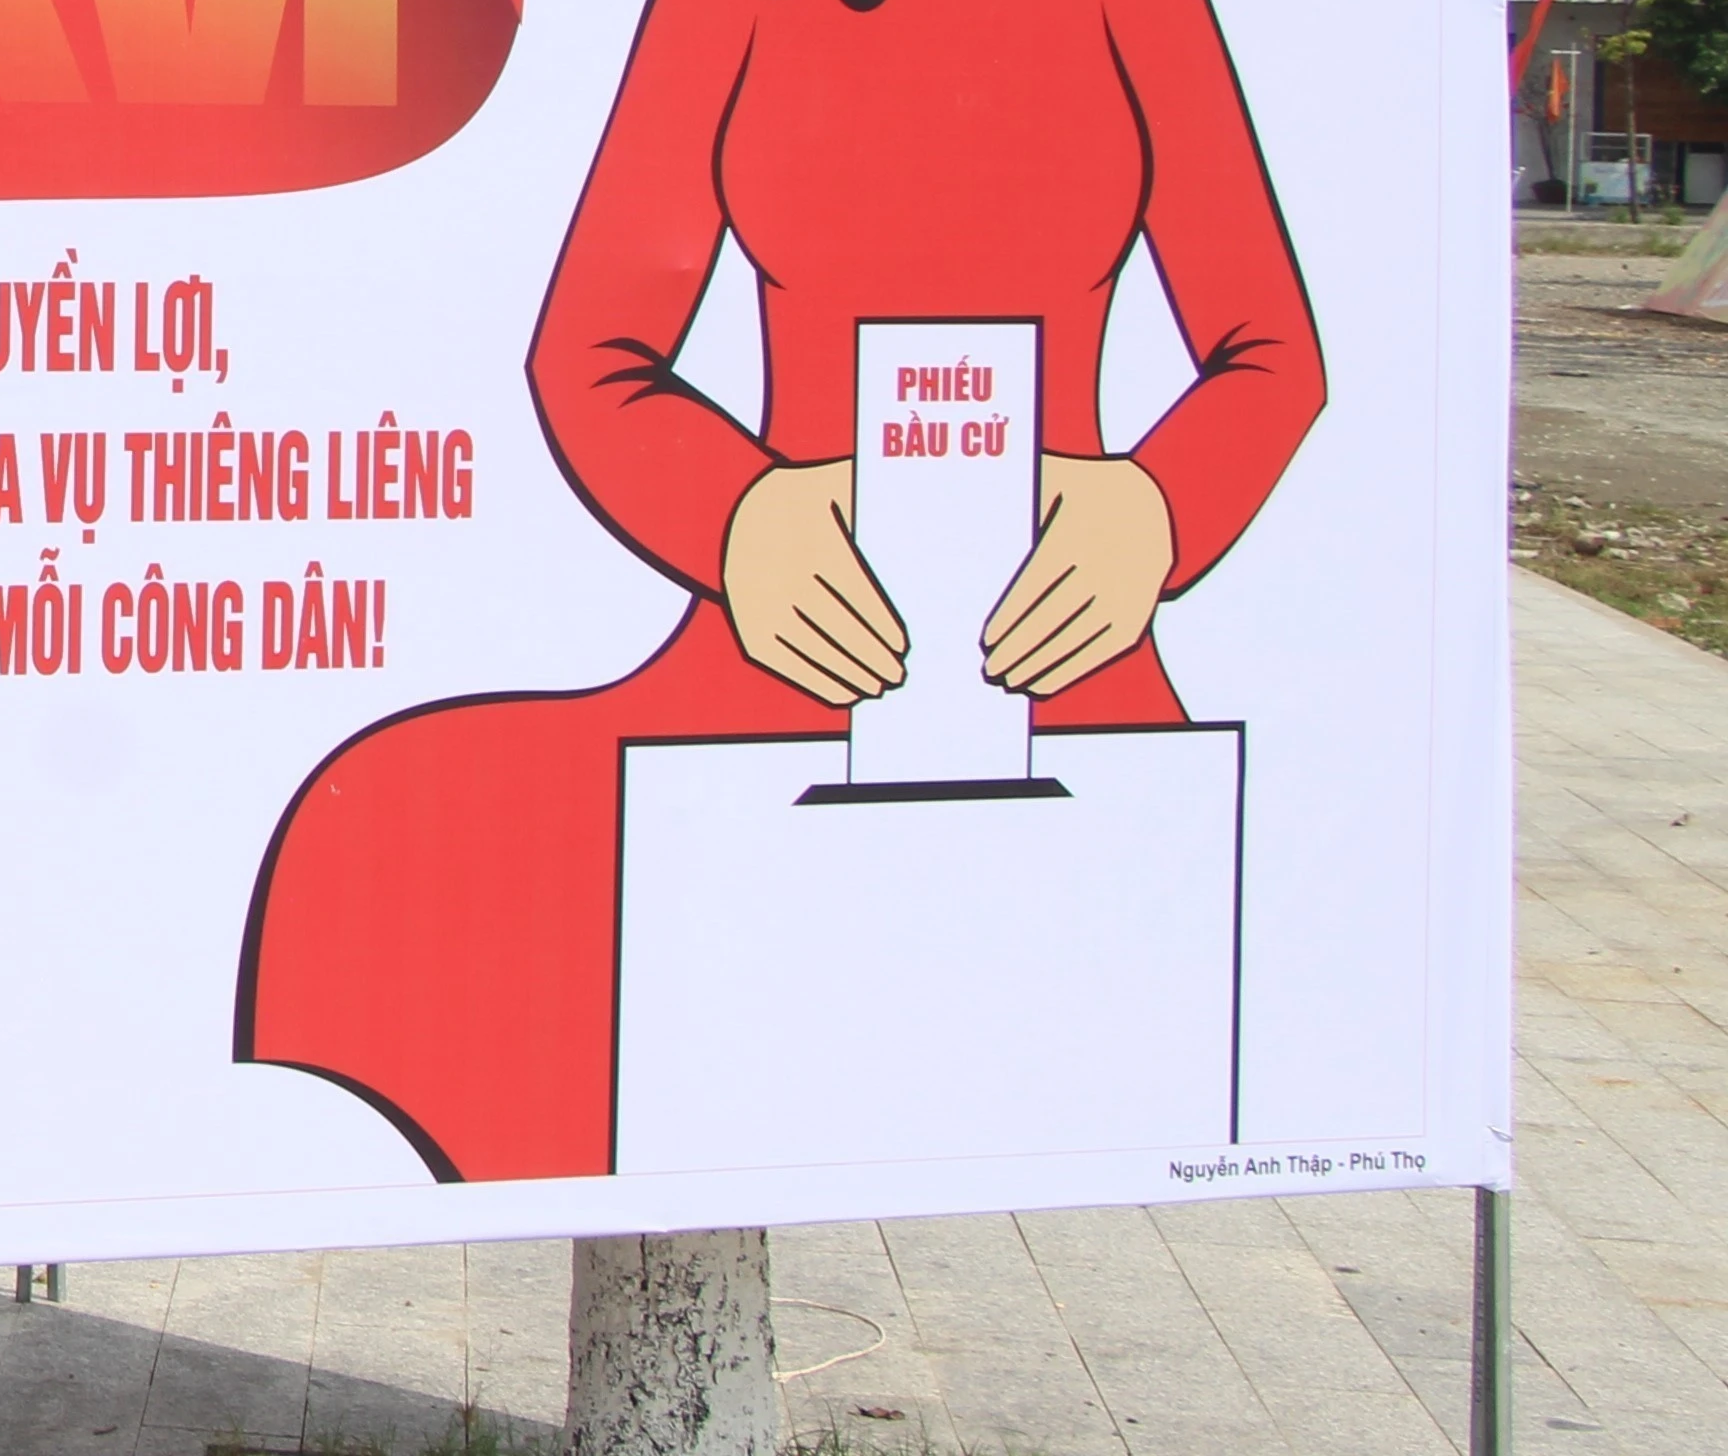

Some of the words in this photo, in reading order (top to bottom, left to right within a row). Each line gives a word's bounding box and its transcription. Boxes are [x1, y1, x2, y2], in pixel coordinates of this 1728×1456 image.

[135, 275, 227, 392] LỢI,
[897, 361, 992, 402] PHIẾU
[882, 416, 948, 457] BẦU
[961, 421, 1007, 457] CỬ
[41, 433, 105, 543] VỤ
[125, 412, 308, 521] THIÊNG
[328, 411, 472, 519] LIÊNG
[102, 564, 243, 673] CÔNG
[262, 562, 384, 669] DÂN!
[1170, 1157, 1238, 1183] Nguyễn
[1244, 1157, 1280, 1175] Anh
[1287, 1155, 1332, 1176] Thập
[1350, 1152, 1385, 1170] Phú
[1391, 1151, 1425, 1172] Thọ
